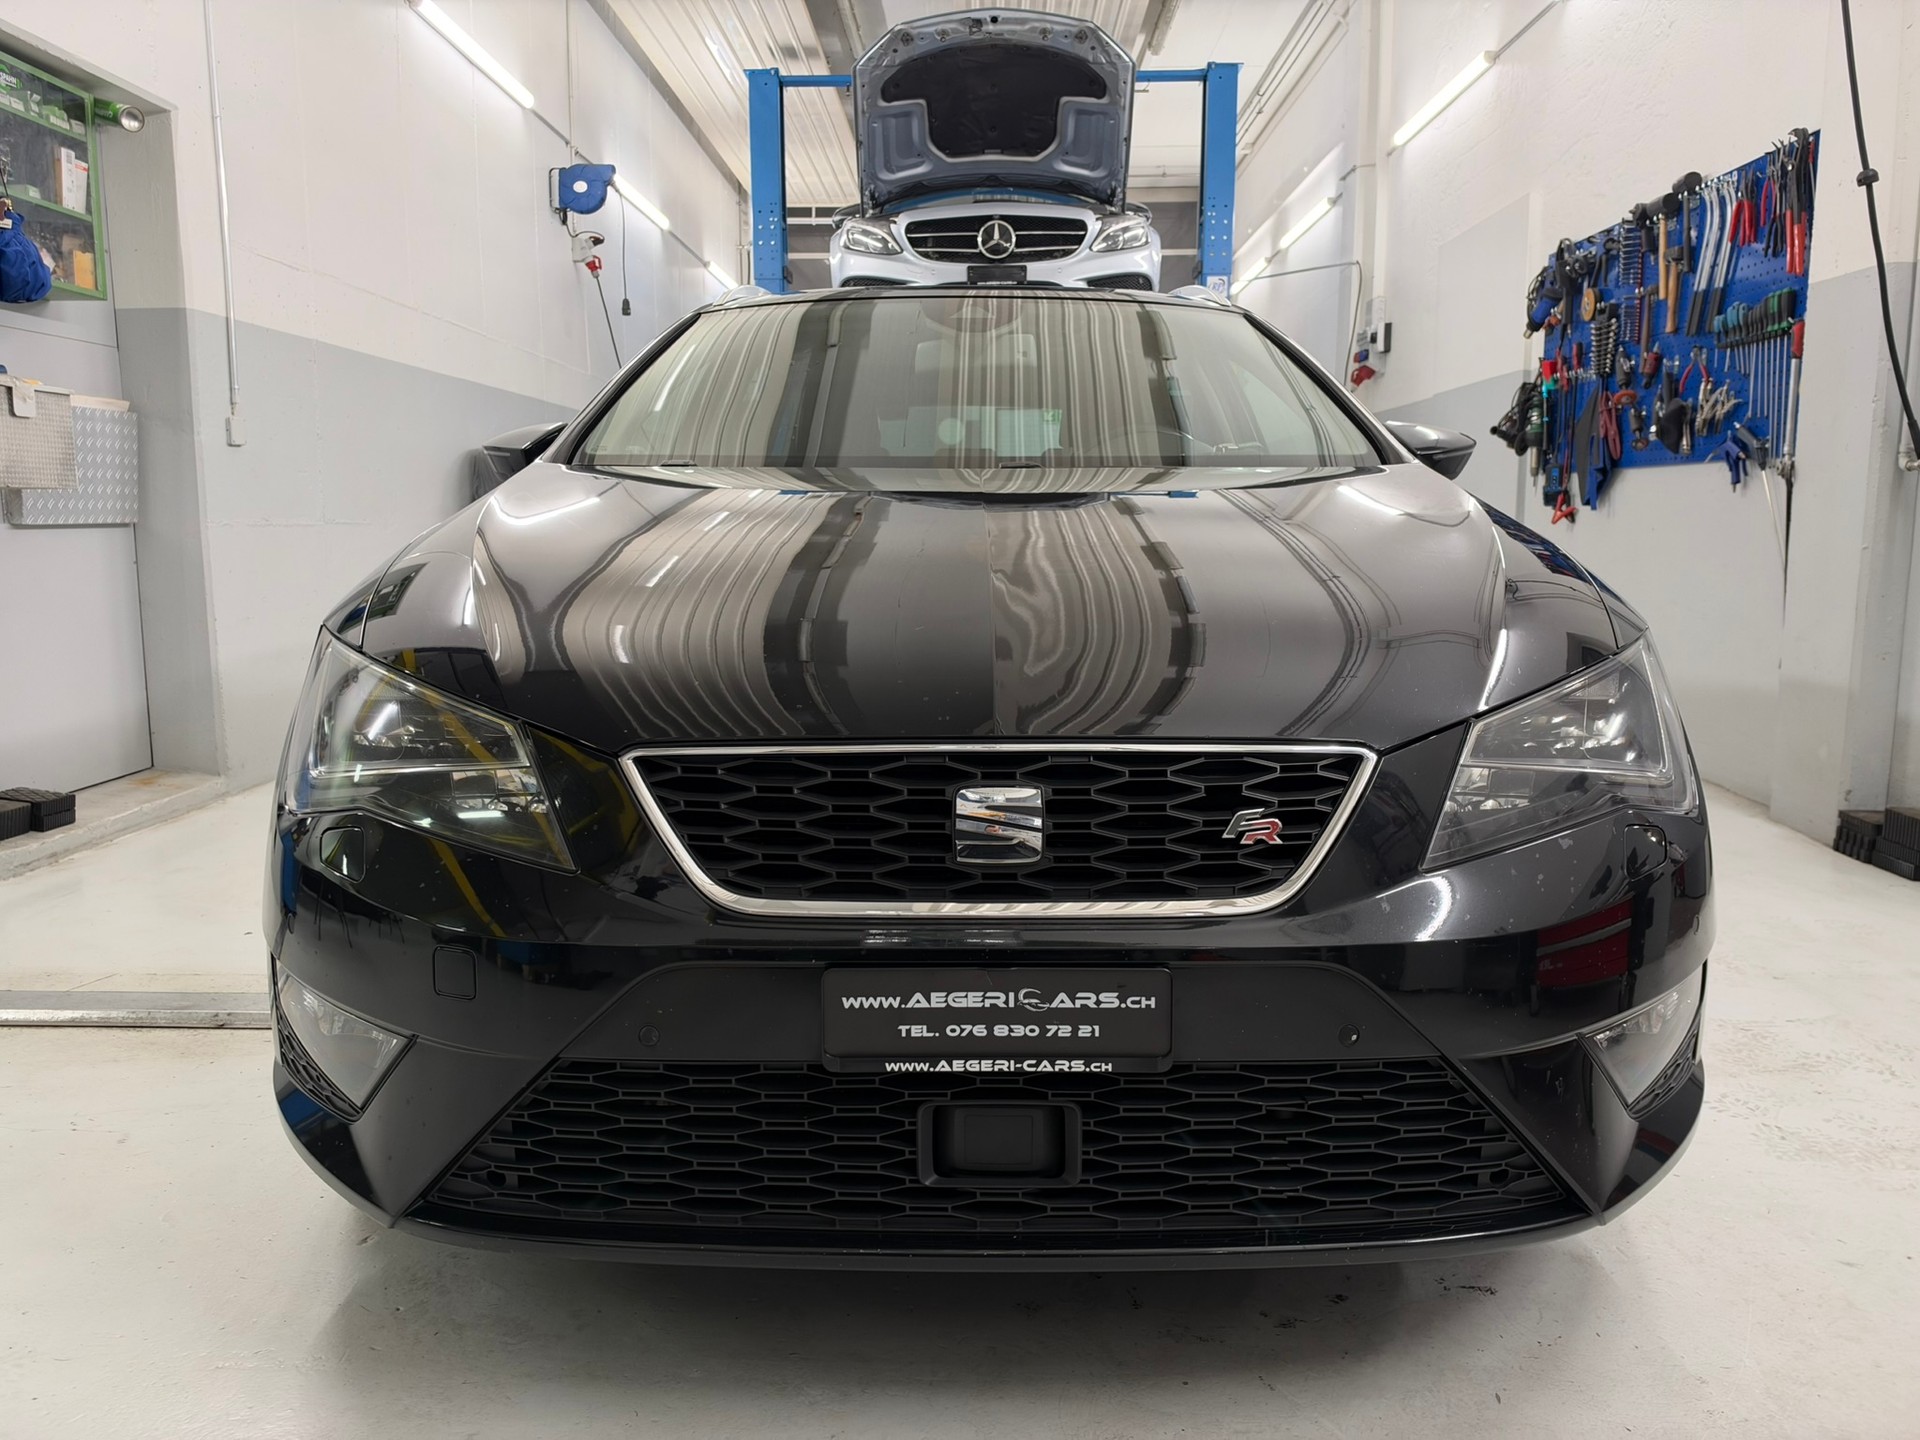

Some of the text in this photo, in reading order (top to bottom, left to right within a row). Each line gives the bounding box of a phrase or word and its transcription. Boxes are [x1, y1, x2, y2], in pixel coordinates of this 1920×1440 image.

[1221, 808, 1283, 844] FR
[897, 1024, 1100, 1037] TEL. 076 830 72 21
